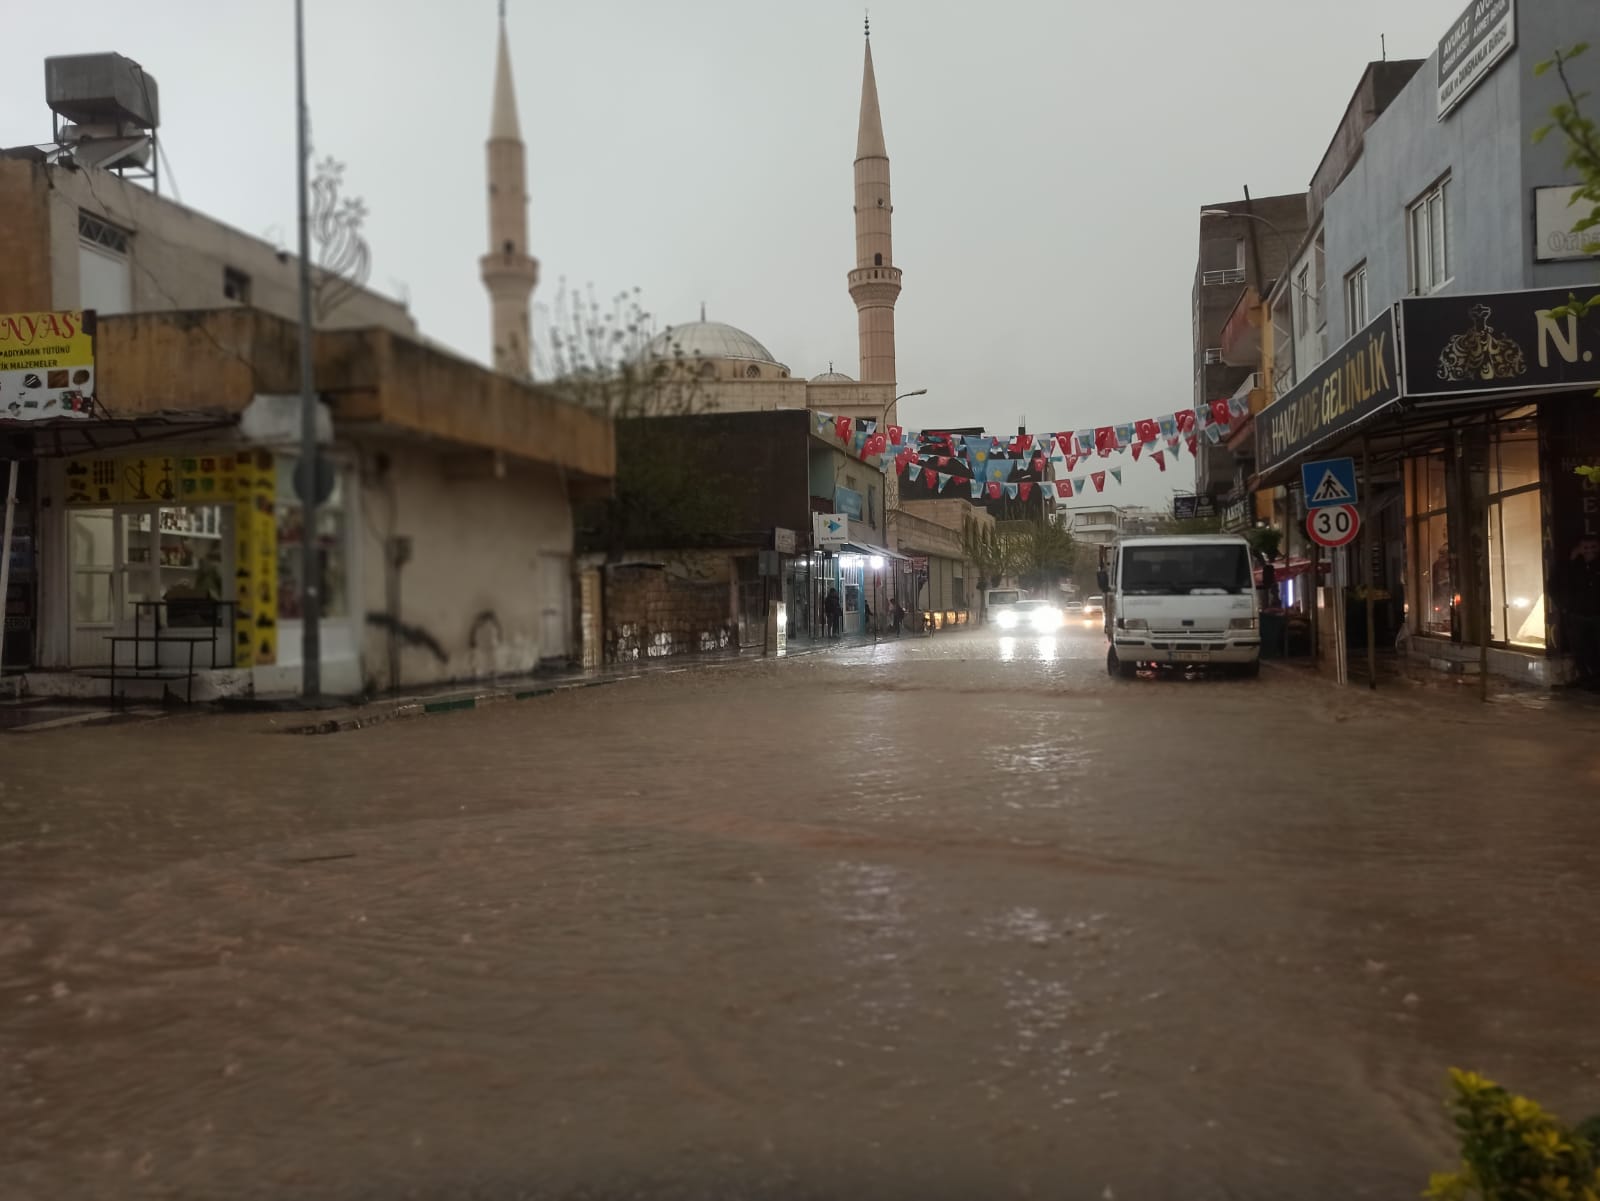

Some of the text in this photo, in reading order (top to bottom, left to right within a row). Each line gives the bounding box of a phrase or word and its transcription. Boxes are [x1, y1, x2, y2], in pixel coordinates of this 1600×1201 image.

[1443, 16, 1470, 58] AVUKAT
[4, 348, 40, 358] ADIYAMAN
[10, 359, 58, 370] MALZEMELER
[1271, 331, 1390, 457] HANZADE GELİNLİK
[1318, 511, 1349, 534] 30
